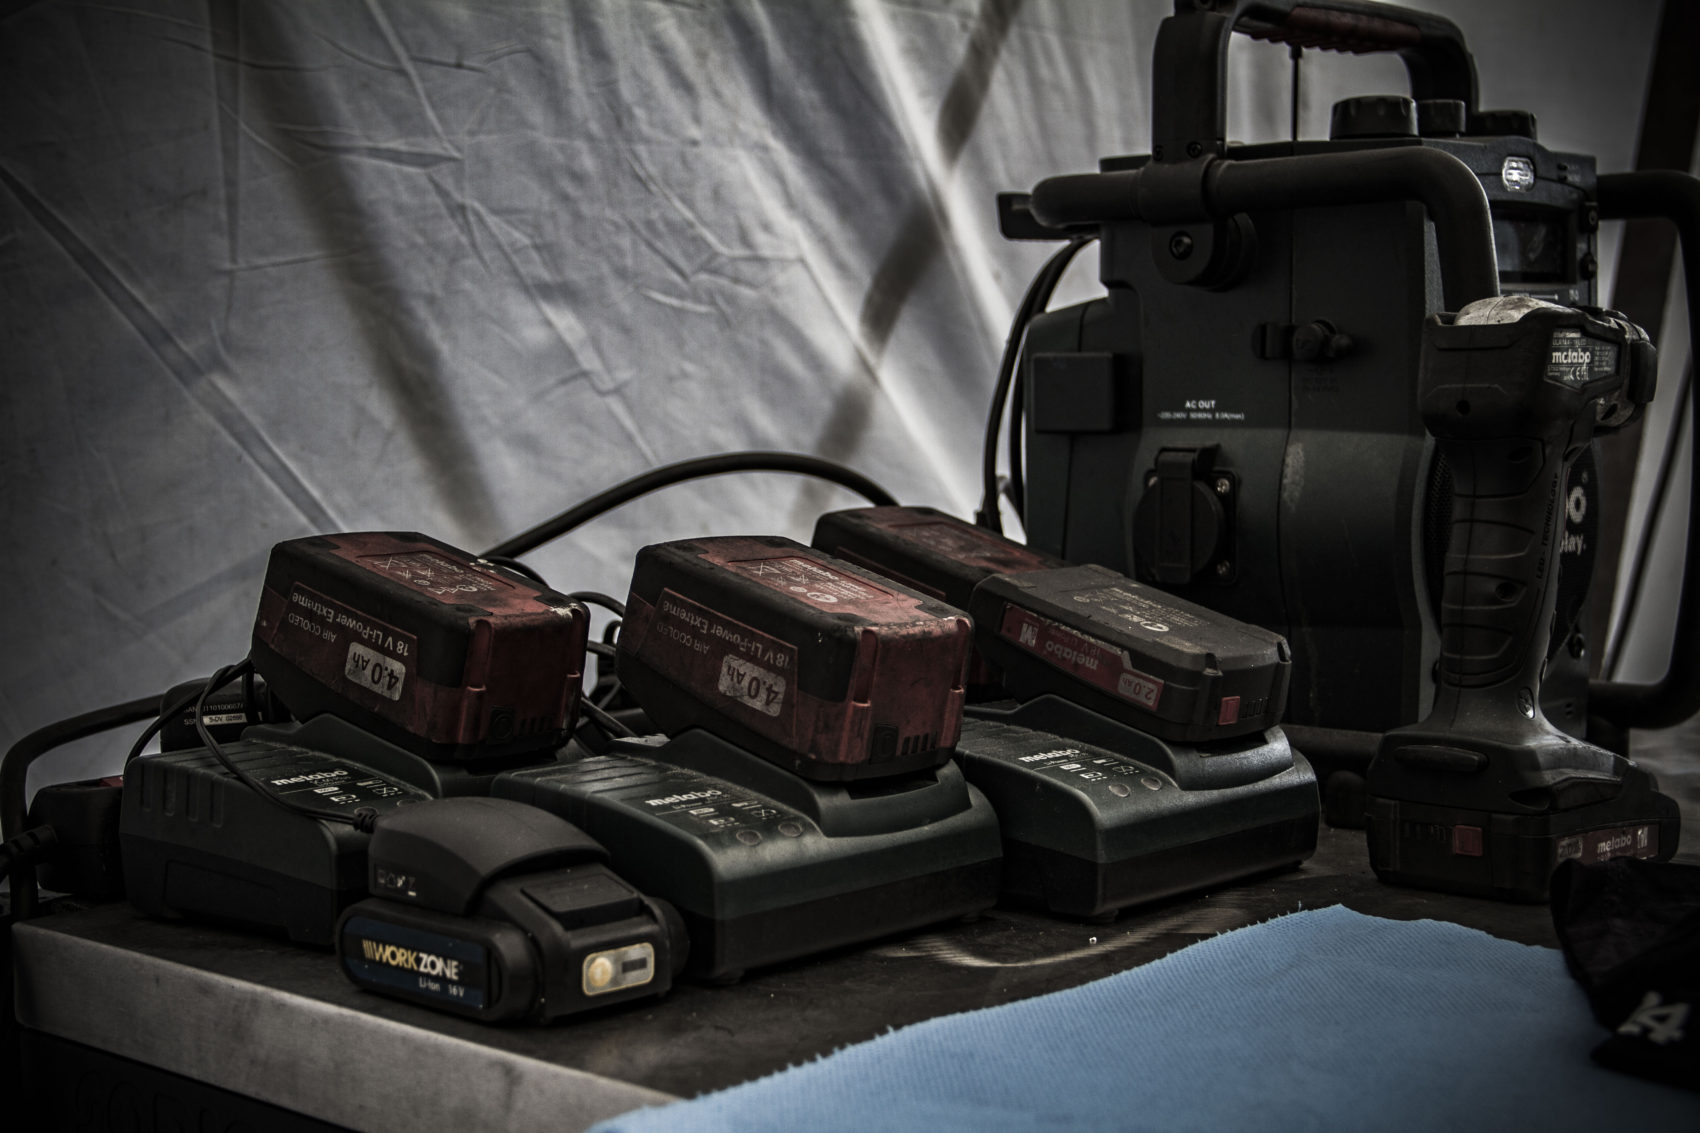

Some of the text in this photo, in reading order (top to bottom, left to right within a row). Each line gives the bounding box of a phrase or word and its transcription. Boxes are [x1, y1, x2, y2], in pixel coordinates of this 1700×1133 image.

[1184, 399, 1216, 409] AC OUT
[288, 612, 338, 643] AIR COOLED
[292, 592, 409, 656] 18 V Li-Power Extreme
[663, 601, 709, 634] Extreme
[693, 641, 711, 655] AIR
[710, 625, 763, 658] Li-Power
[776, 653, 790, 668] 18
[1044, 640, 1099, 670] metabo
[352, 652, 399, 691] 4.0 Ah
[726, 664, 779, 706] 4.0 Ah
[1132, 684, 1154, 701] 2.0
[1018, 748, 1080, 762] metabo
[270, 768, 349, 786] metabo
[645, 788, 722, 806] metabo
[1597, 834, 1632, 854] metabo
